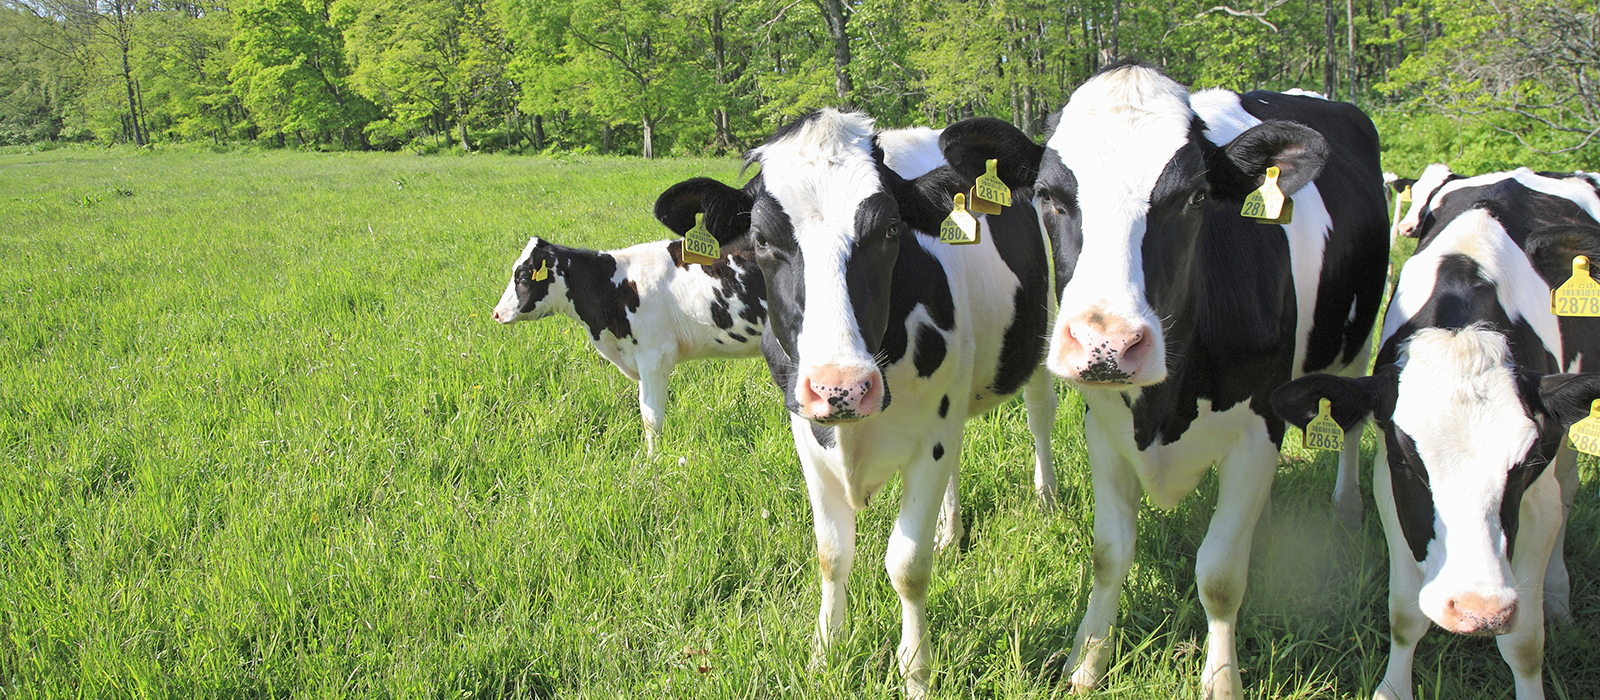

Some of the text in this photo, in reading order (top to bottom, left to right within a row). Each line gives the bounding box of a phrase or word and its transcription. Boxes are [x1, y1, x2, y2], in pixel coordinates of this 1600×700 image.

[980, 185, 1005, 204] 2811
[687, 238, 714, 256] 2802
[1559, 297, 1600, 314] 2878
[1309, 432, 1339, 449] 2863
[1572, 433, 1600, 453] 286
